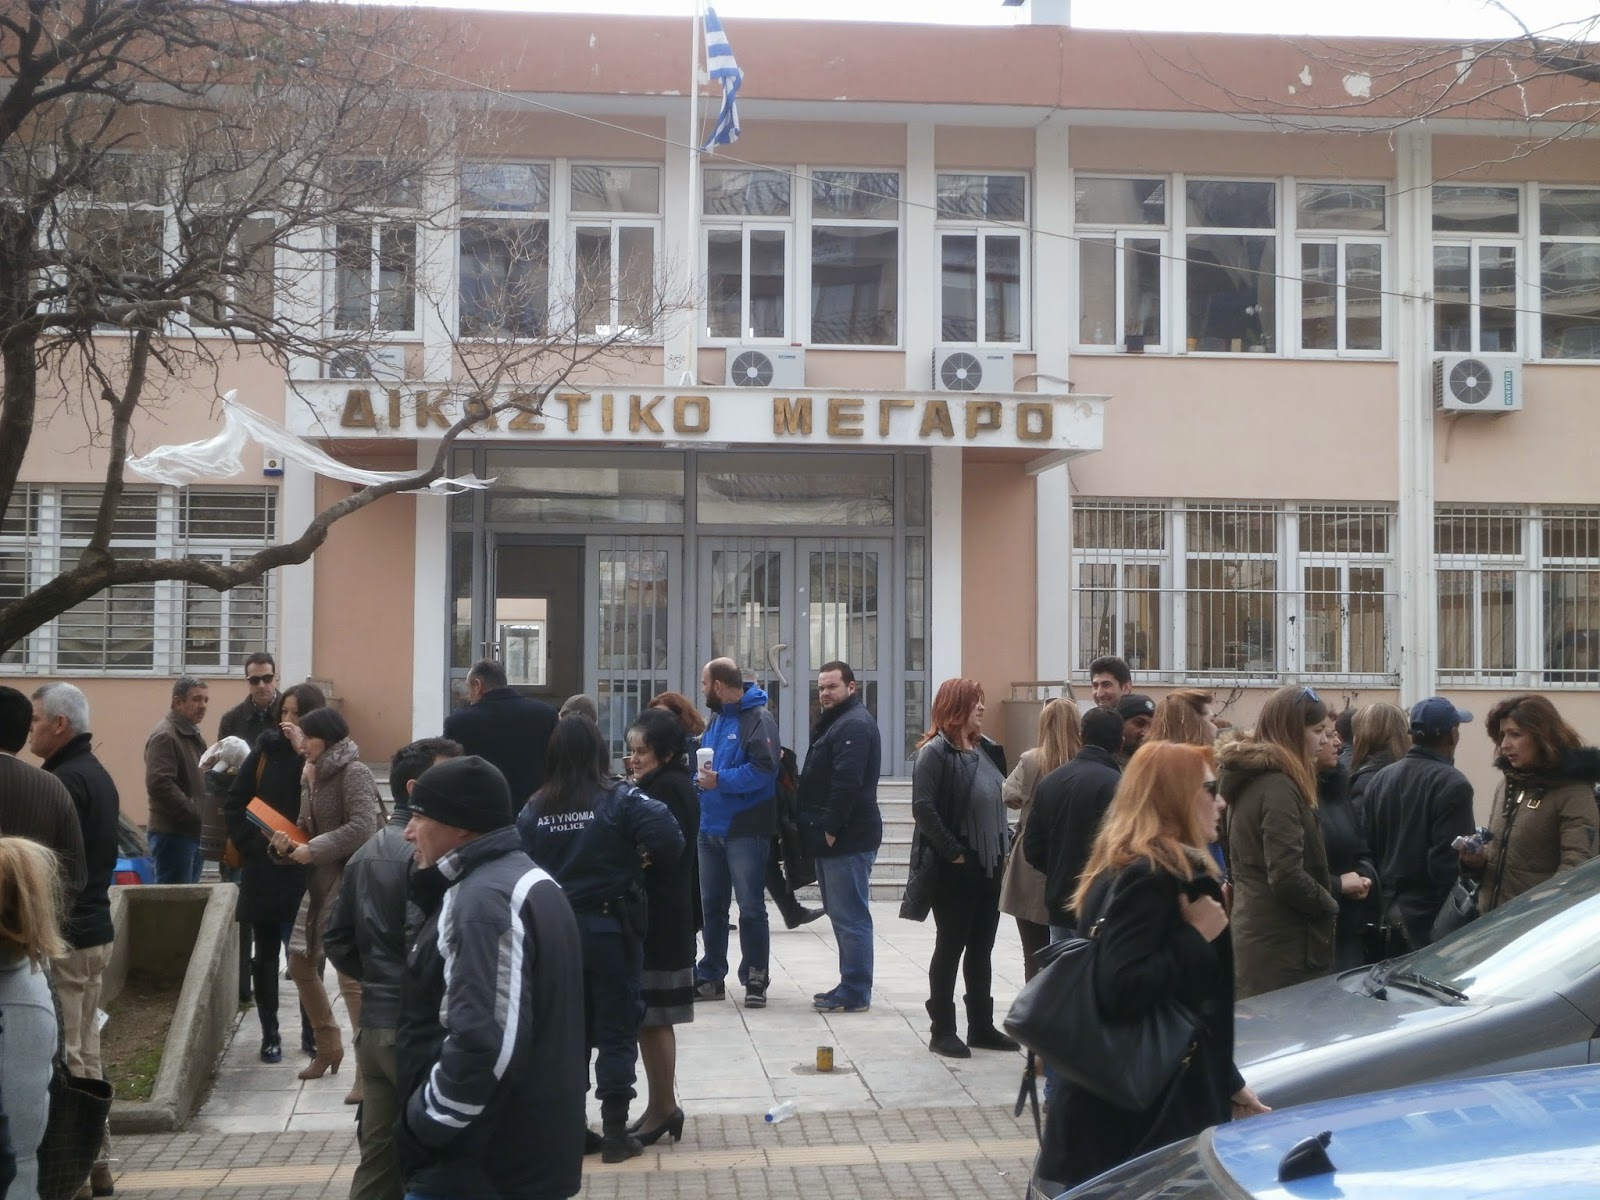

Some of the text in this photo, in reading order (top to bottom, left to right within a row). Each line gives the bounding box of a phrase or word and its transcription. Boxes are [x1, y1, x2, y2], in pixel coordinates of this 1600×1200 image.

[1505, 371, 1513, 405] INVERTER
[773, 397, 1054, 440] ΜΕΓΑΡΟ
[537, 811, 595, 826] ΑΣΤΥΝΟΜΙΑ
[550, 822, 585, 832] POLICE
